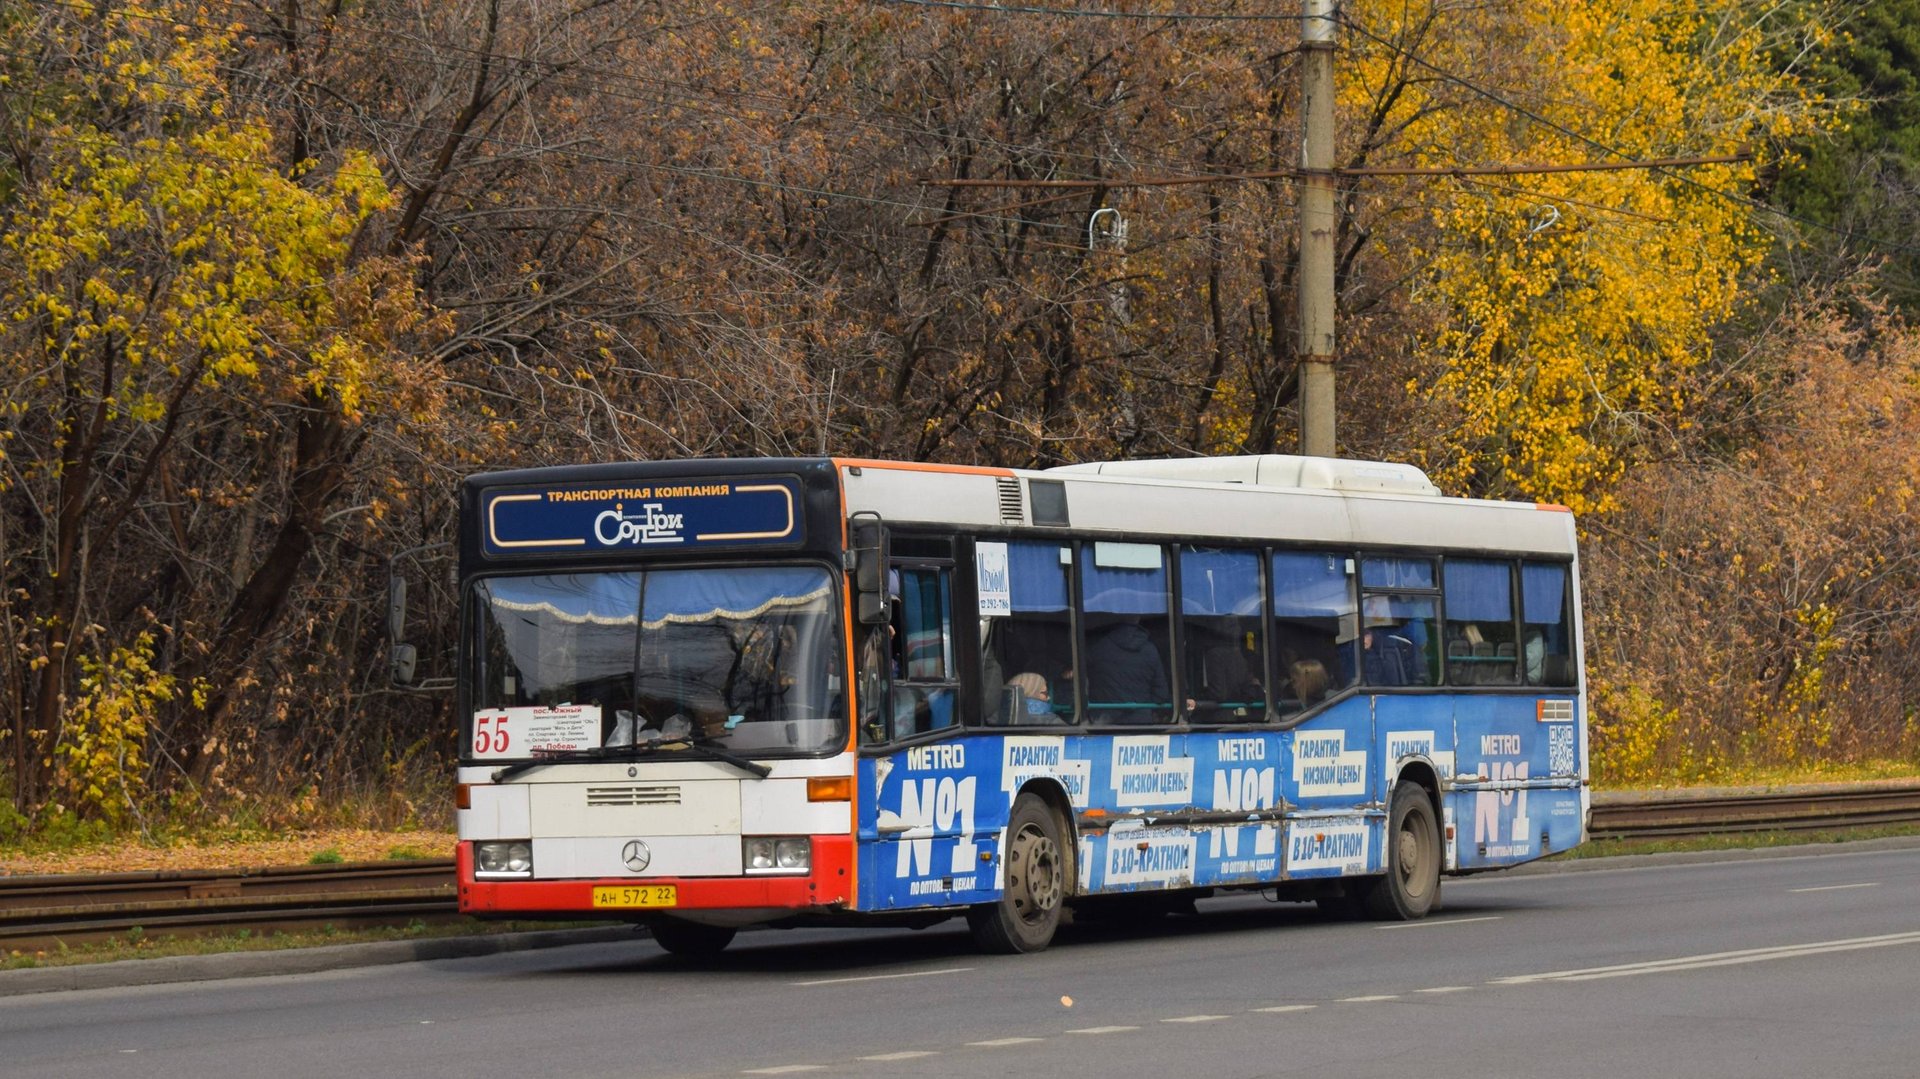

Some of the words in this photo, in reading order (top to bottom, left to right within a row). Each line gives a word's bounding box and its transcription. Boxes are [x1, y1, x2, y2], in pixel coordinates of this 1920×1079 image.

[547, 487, 651, 502] ТРАНСПОРТНАЯ
[655, 484, 730, 498] КОМПАНИЯ
[475, 716, 510, 753] 55
[1481, 734, 1520, 755] METRO
[547, 743, 577, 751] Победы
[907, 744, 965, 771] METRO
[1010, 746, 1059, 766] ГАРАНТИЯ
[1118, 744, 1164, 766] ГАРАНТИЯ
[1218, 738, 1266, 761] METRO
[1299, 739, 1340, 758] ГАРАНТИЯ
[1122, 766, 1159, 794] НИЗКОЙ
[1303, 759, 1336, 785] НИЗКОЙ
[1293, 836, 1301, 861] В
[1301, 832, 1363, 860] 10-КРАТНОМ
[1112, 848, 1120, 875] В
[1121, 844, 1190, 874] 10-КРАТНОМ
[601, 893, 616, 904] АН
[624, 889, 648, 904] 572
[657, 888, 671, 899] 22
[910, 881, 920, 895] ПО
